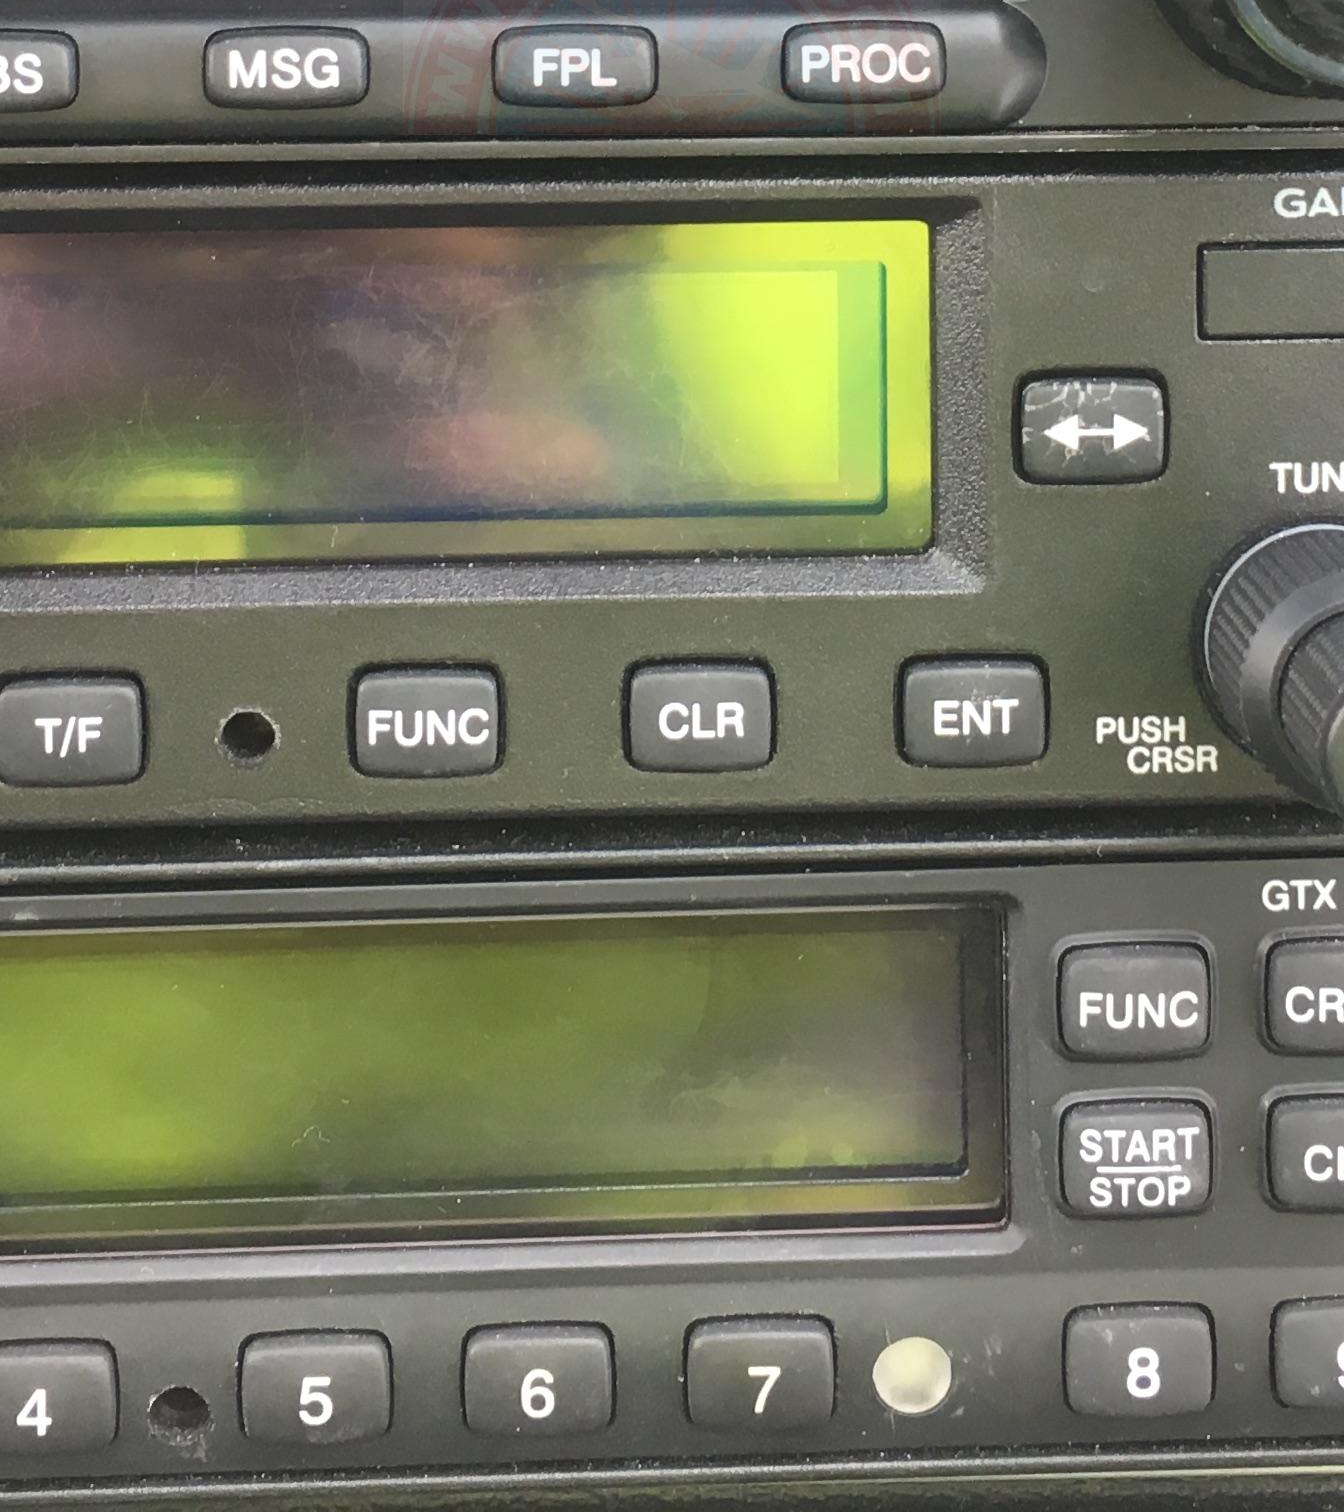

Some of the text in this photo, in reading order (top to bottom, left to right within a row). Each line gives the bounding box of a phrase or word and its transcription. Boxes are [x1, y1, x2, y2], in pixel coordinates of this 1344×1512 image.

[228, 47, 340, 90] MSG
[532, 47, 618, 87] FPL
[801, 42, 931, 84] PROC
[34, 715, 104, 758] T/F
[368, 707, 490, 747] FUNC
[658, 701, 745, 740] CLR
[933, 698, 1020, 737] ENT
[1095, 715, 1186, 745] PUSH
[1126, 745, 1218, 775] CRSR
[1261, 878, 1337, 912] GTX
[1079, 990, 1199, 1030] FUNC
[1079, 1126, 1201, 1163] START
[1089, 1174, 1192, 1208] STOP
[747, 1365, 782, 1414] 7
[1126, 1346, 1161, 1399] 8
[16, 1388, 53, 1437] 4
[298, 1375, 334, 1426] 5
[520, 1368, 555, 1419] 6
